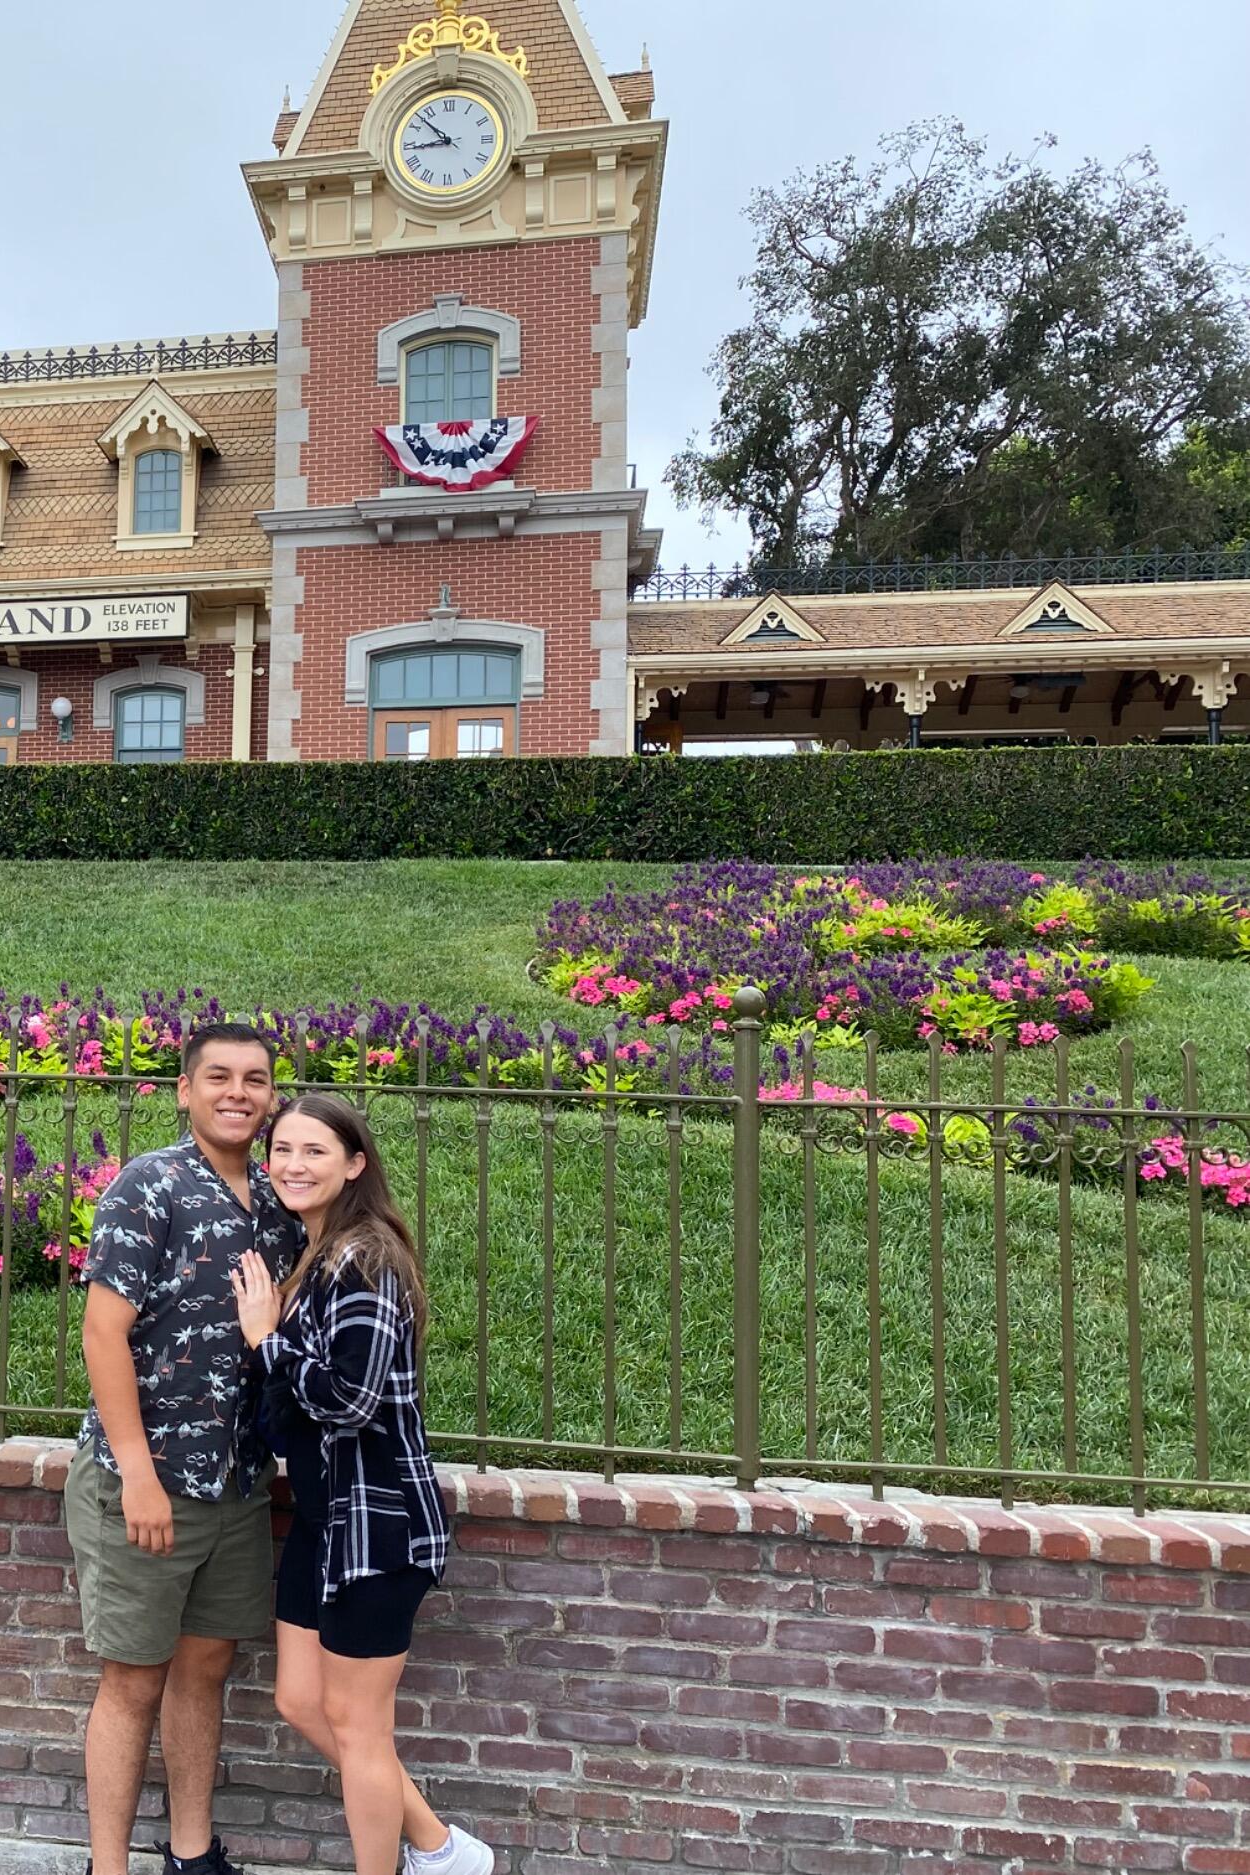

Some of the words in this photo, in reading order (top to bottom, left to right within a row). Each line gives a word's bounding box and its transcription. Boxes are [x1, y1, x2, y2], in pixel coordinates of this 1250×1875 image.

[103, 602, 176, 616] ELEVATION
[107, 620, 129, 632] 138
[135, 618, 169, 631] FEET
